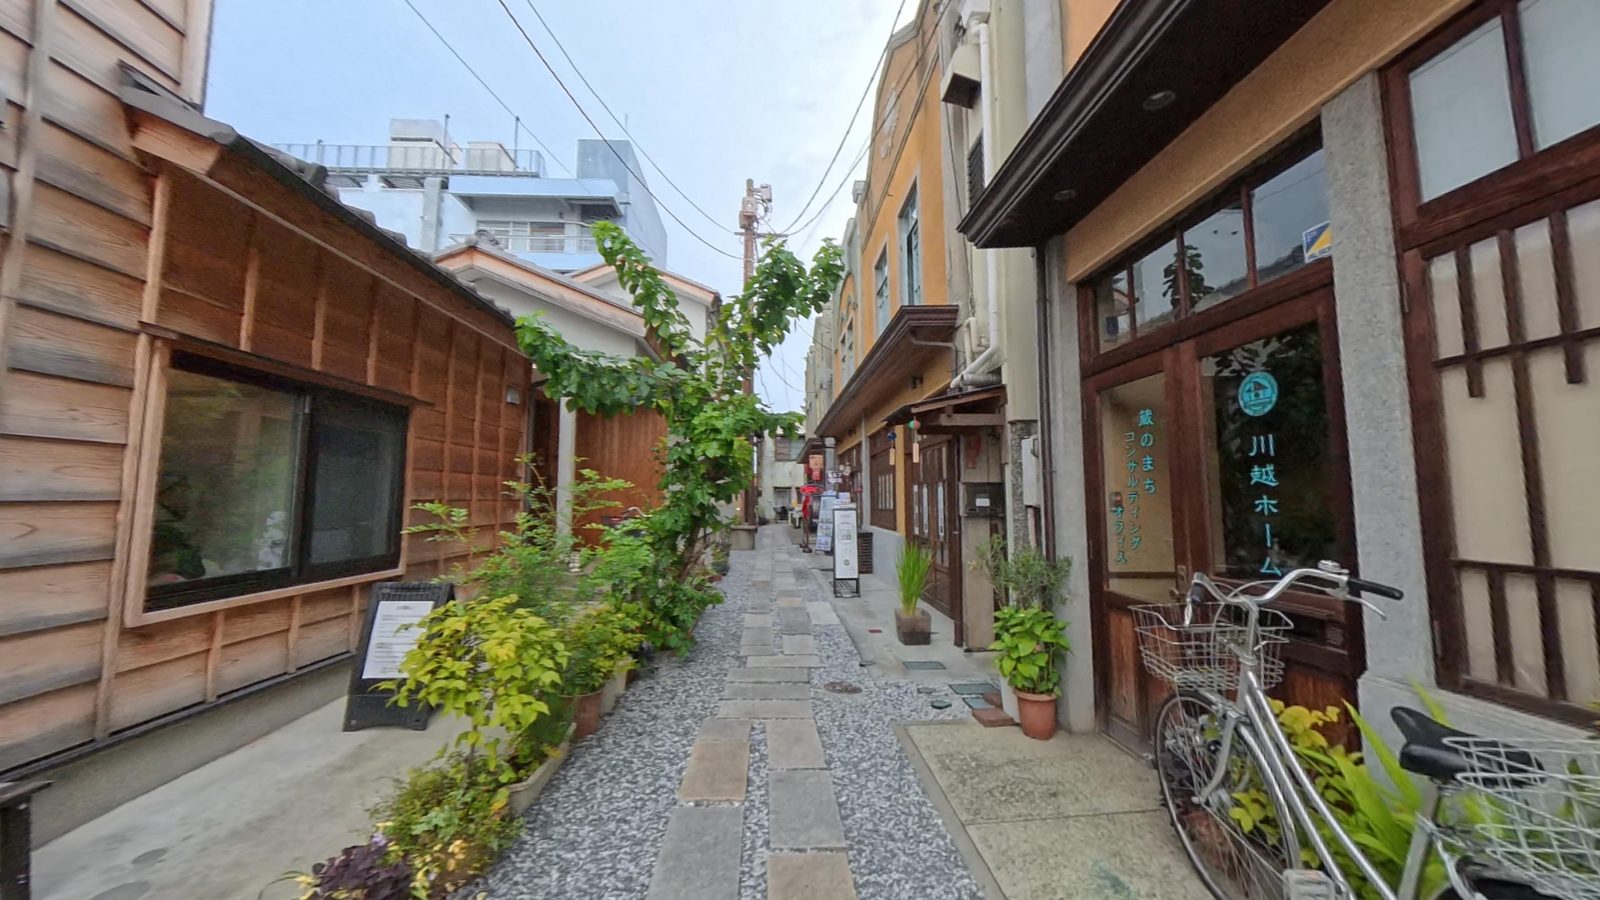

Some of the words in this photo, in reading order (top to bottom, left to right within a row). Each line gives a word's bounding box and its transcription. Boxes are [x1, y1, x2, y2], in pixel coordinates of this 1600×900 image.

[1124, 431, 1141, 550] コンサルティング
[1138, 409, 1156, 494] 蔵のまち
[1111, 504, 1127, 565] オフィス
[1248, 434, 1281, 577] 川越ホーム
